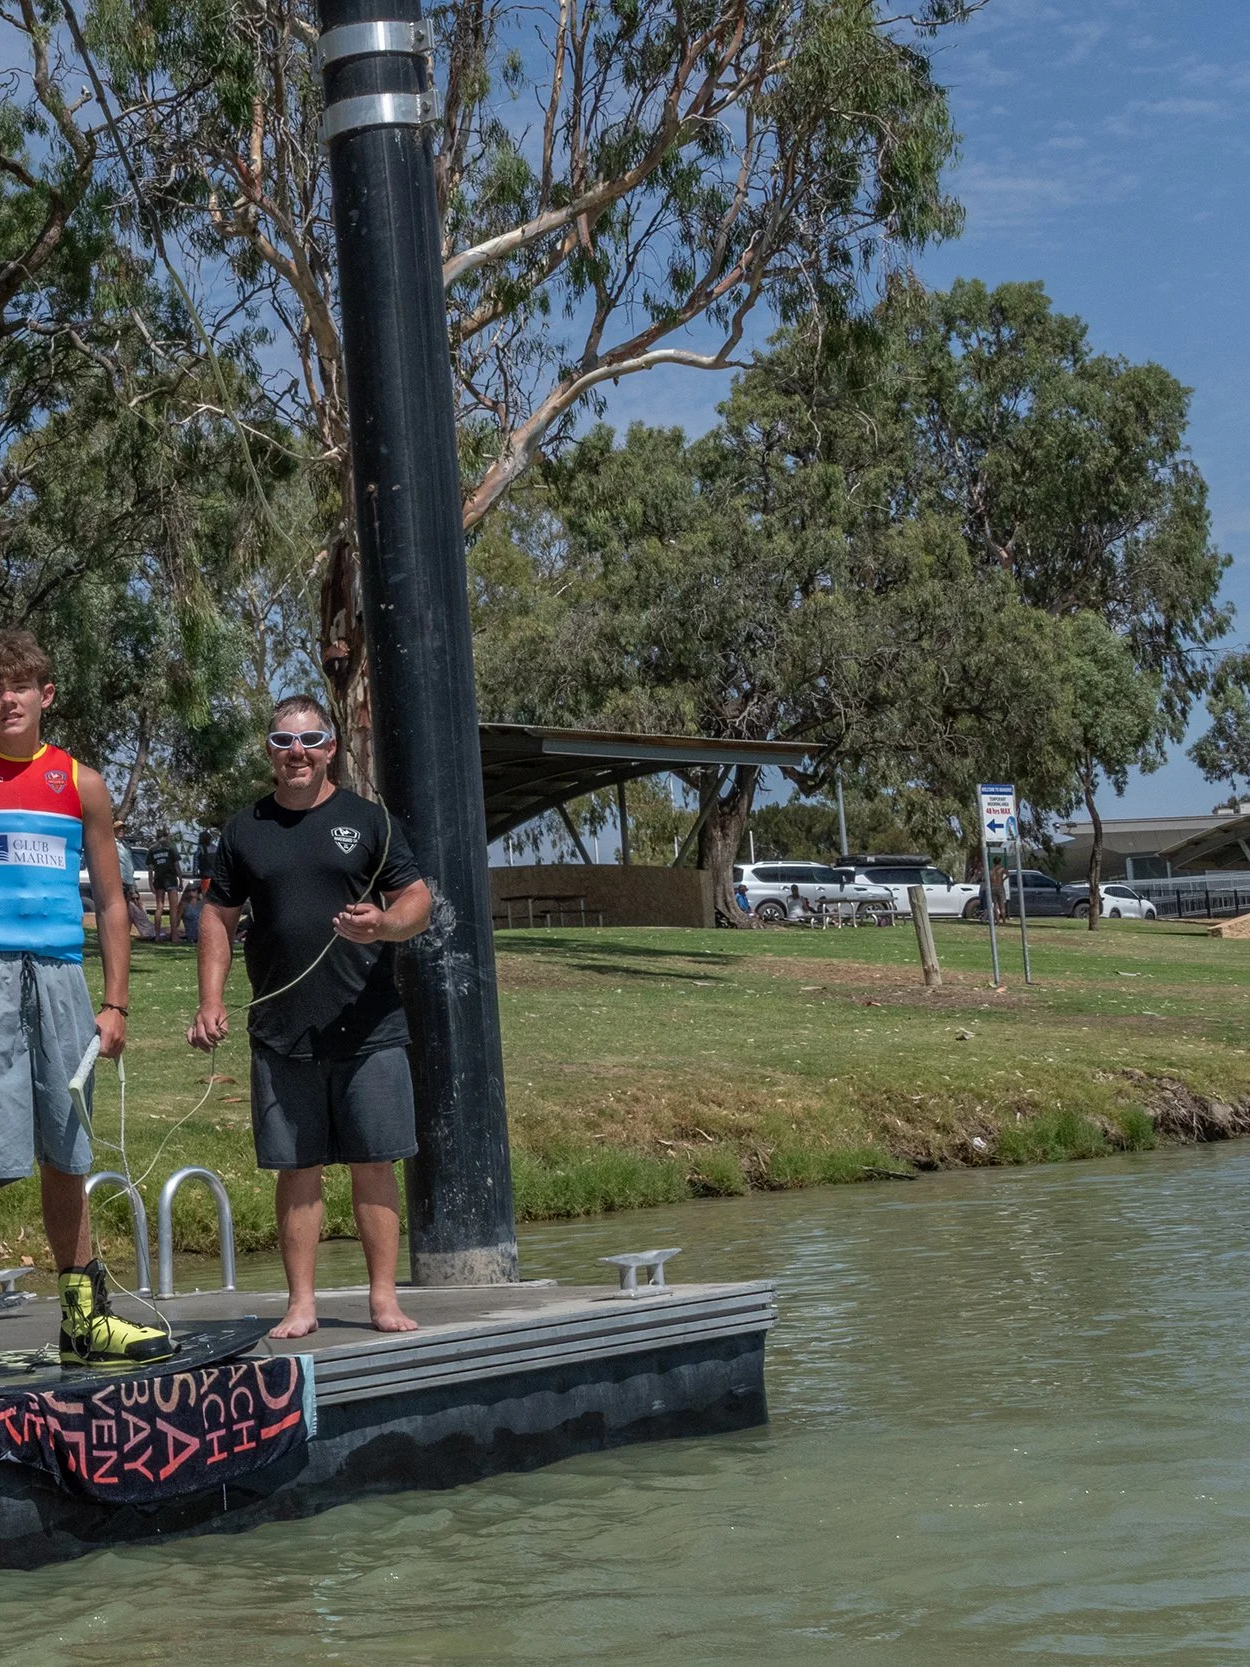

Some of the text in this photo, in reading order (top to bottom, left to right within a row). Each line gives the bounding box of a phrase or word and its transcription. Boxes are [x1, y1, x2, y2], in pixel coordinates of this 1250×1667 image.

[12, 839, 49, 852] CLUB
[13, 852, 65, 867] MARINE
[92, 1384, 119, 1483] VEN
[120, 1380, 155, 1482] BAY
